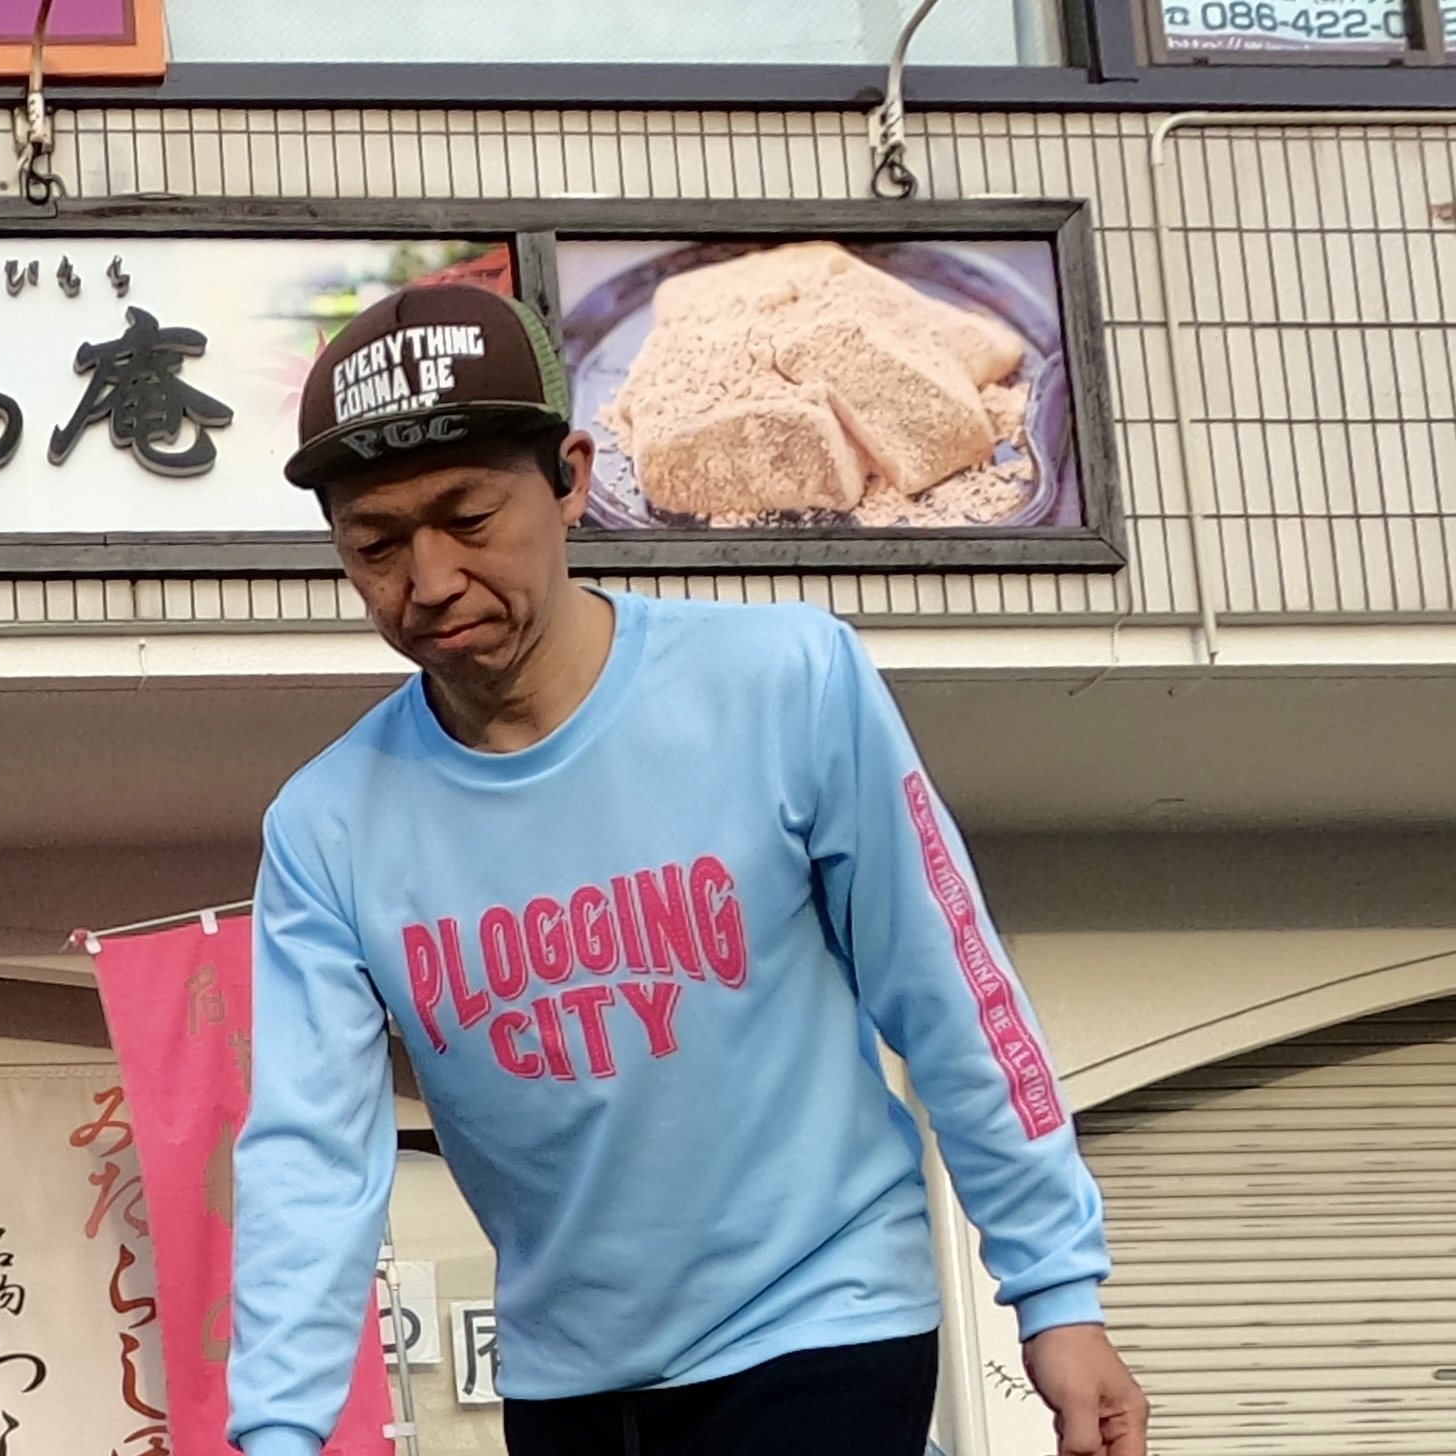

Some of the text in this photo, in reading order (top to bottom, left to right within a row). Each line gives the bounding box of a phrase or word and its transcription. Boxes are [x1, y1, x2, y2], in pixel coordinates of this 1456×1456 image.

[332, 325, 485, 393] EVERYTHING
[334, 365, 411, 424] GONNA
[418, 356, 456, 394] BE
[402, 853, 748, 1054] PLOGGING
[488, 981, 683, 1081] CITY
[989, 1004, 1012, 1034] BE
[1005, 1041, 1056, 1127] ALRIGHT
